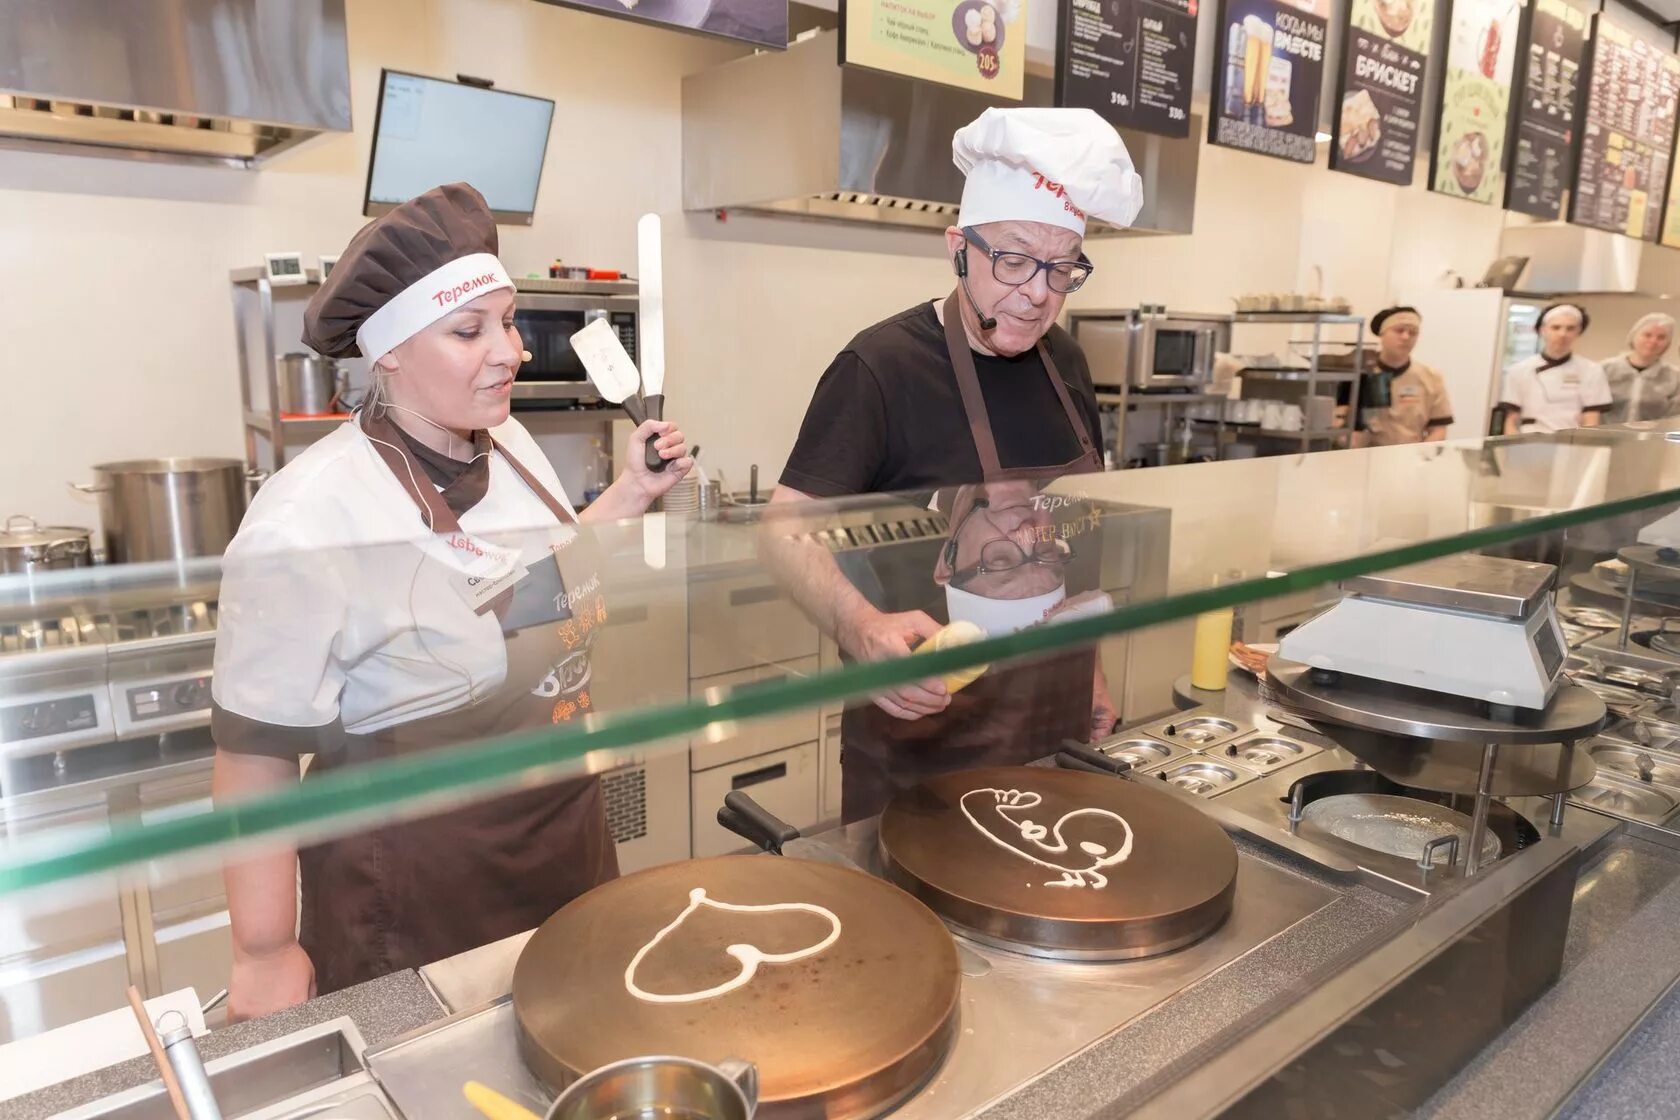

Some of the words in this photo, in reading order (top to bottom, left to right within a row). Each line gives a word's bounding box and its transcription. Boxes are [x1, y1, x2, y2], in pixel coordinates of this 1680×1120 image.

[1275, 11, 1307, 37] КОГДА
[1307, 23, 1325, 43] МЫ
[1274, 29, 1322, 62] ВМЕСТЕ
[1355, 54, 1419, 95] БРИСКЕТ
[431, 272, 499, 307] Теремок
[552, 571, 601, 612] Теремок
